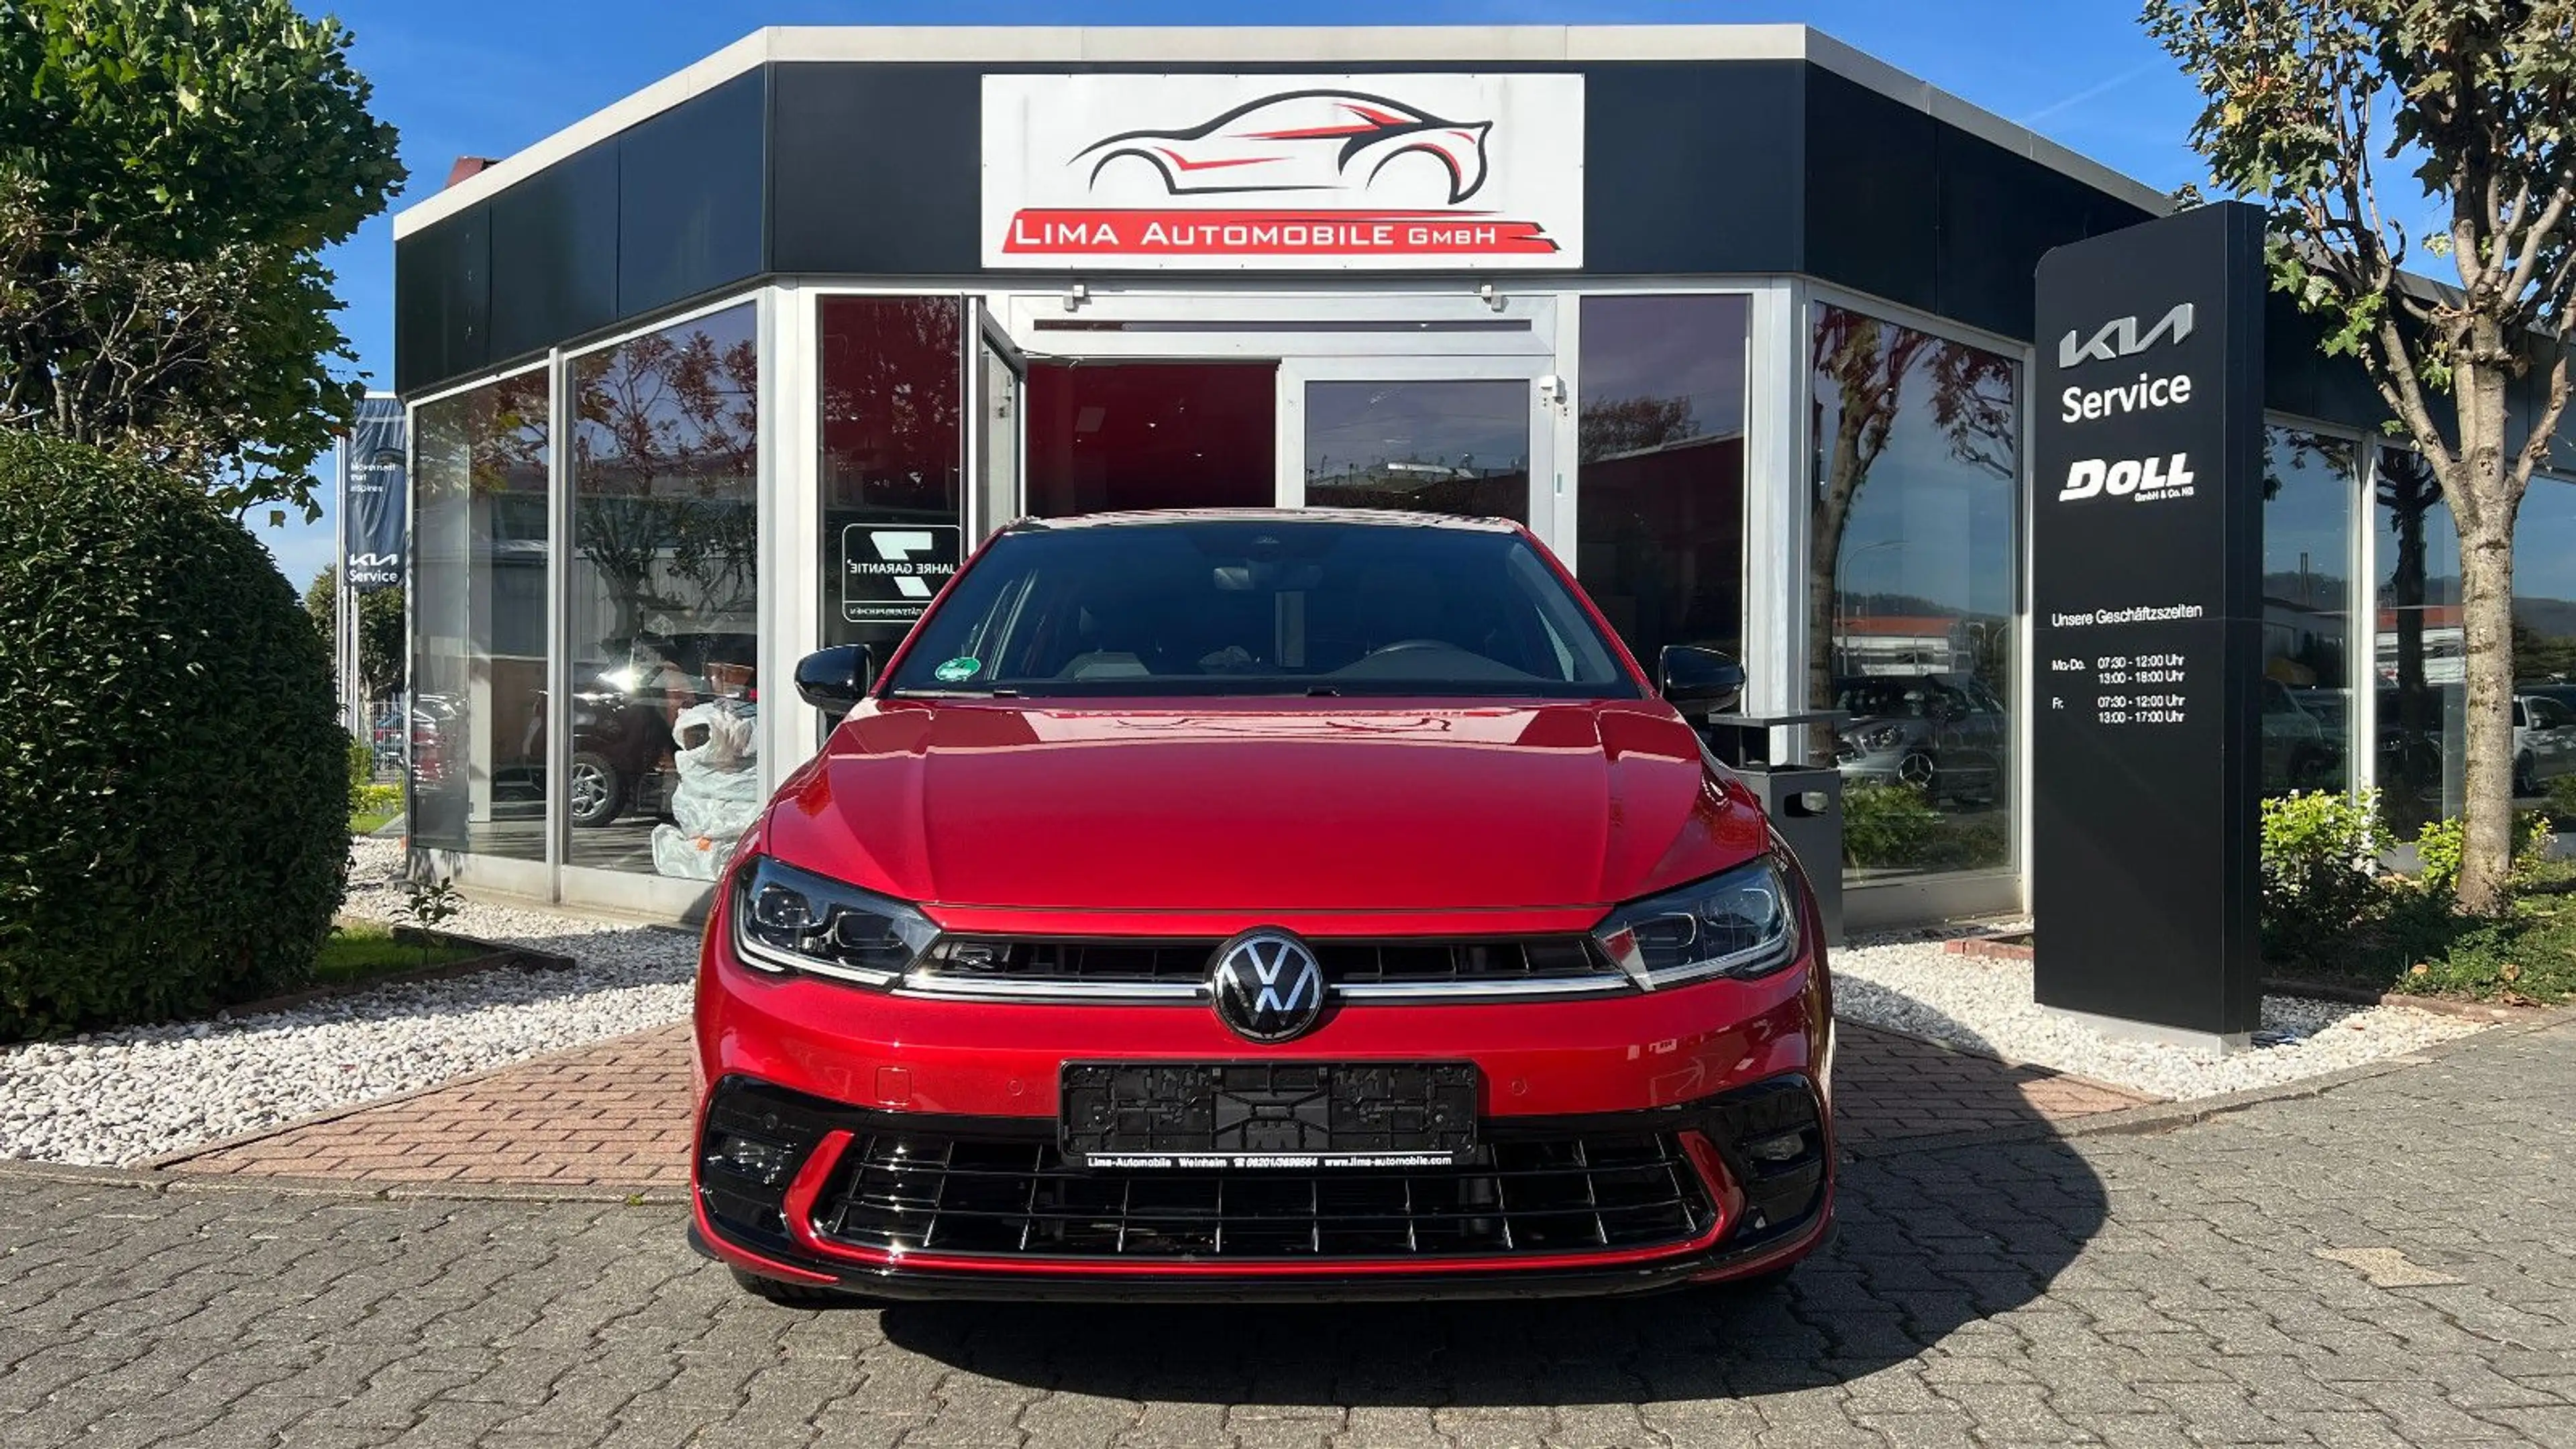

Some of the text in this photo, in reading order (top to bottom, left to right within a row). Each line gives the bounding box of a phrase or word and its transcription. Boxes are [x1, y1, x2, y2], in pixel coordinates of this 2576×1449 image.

[2059, 303, 2194, 368] KIA
[2062, 372, 2191, 423] Service
[2059, 452, 2194, 502] DOLL
[349, 569, 398, 582] Service
[2052, 613, 2094, 627] Unsere
[2098, 655, 2126, 669] 07:30
[2135, 653, 2163, 667] 12:00
[2165, 653, 2184, 665] Uhr
[2098, 672, 2126, 684] 13:00
[2135, 670, 2163, 682] 18:00
[2165, 670, 2185, 682] Uhr
[2052, 696, 2064, 709] Fr.
[2098, 694, 2126, 708] 07:30
[2135, 694, 2163, 707] 12:00
[2165, 694, 2185, 706] Uhr
[2098, 711, 2126, 724] 13:00
[2135, 710, 2163, 722] 17:00
[2165, 710, 2185, 722] Uhr
[1087, 1157, 1171, 1167] Lima-Automobile
[1178, 1157, 1227, 1168] Weinheim
[1325, 1156, 1452, 1167] www.lima-automobile.com
